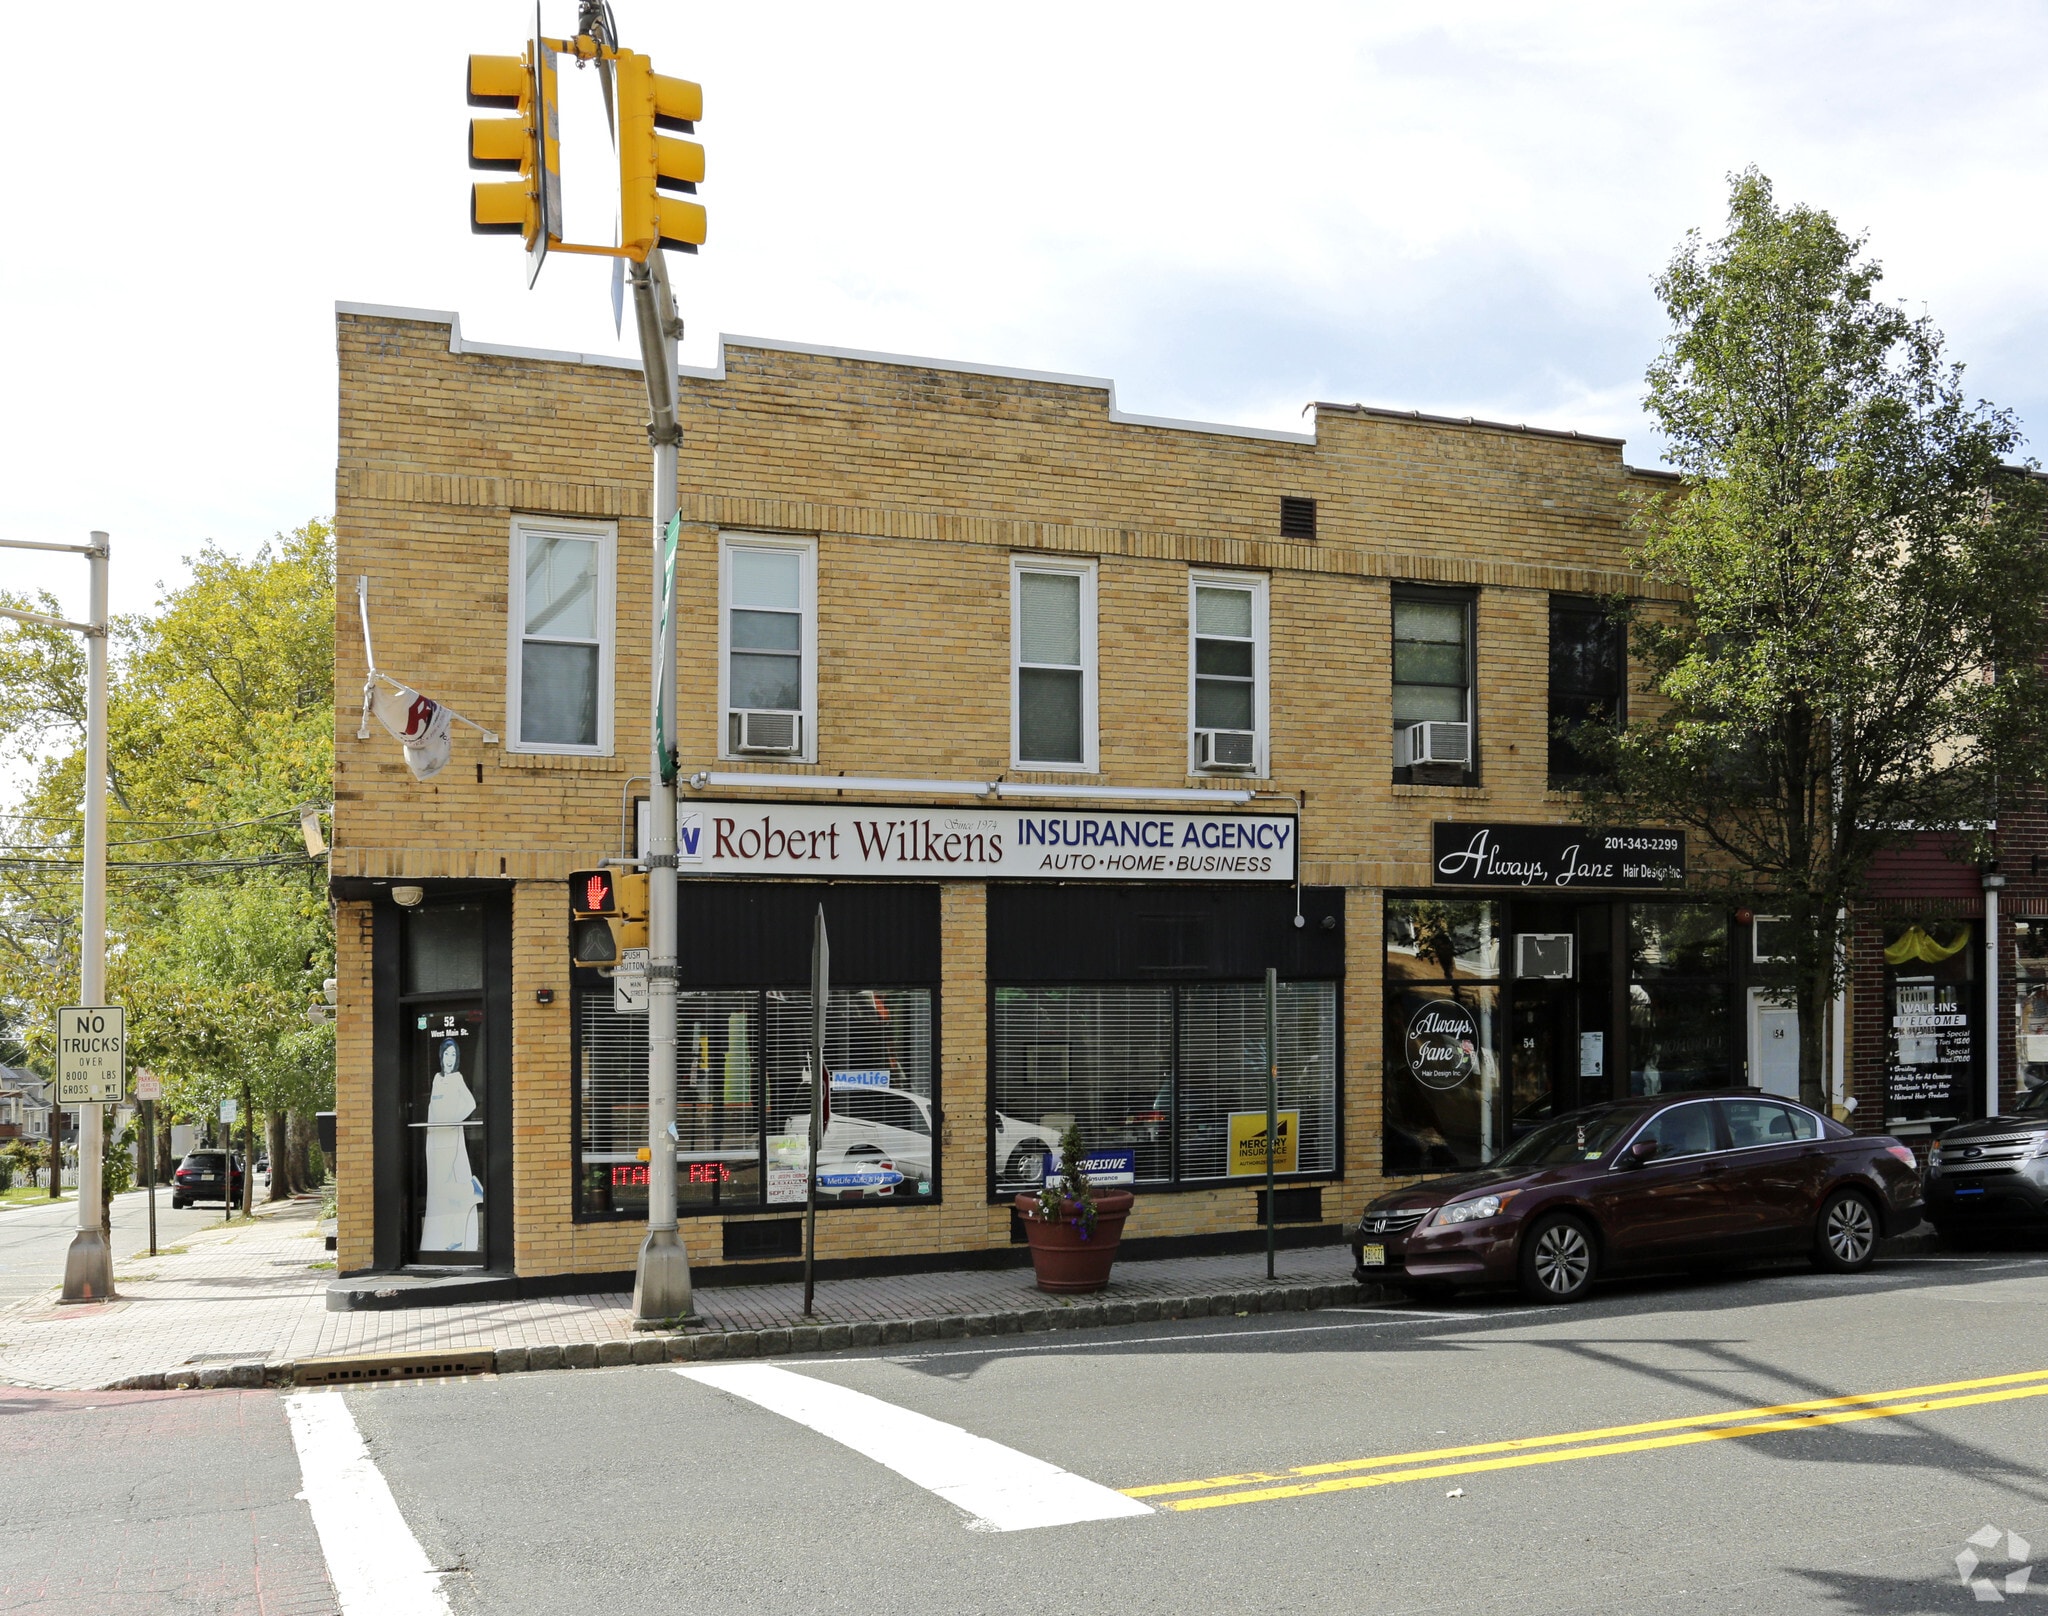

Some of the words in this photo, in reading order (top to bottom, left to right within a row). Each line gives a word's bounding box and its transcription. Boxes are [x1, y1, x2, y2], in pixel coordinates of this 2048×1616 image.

[944, 818, 973, 830] Since
[976, 820, 998, 830] 1974
[712, 816, 840, 861] Robert
[853, 818, 1003, 863] Wilkens
[1017, 818, 1174, 848] INSURANCE
[1181, 822, 1290, 850] AGENCY
[1604, 836, 1678, 850] 201-343-2299
[1438, 829, 1549, 886] Always,
[1555, 844, 1614, 886] Jane
[1623, 864, 1640, 878] Hair
[1640, 864, 1668, 881] Design
[624, 952, 640, 960] PUSH
[621, 962, 644, 970] BUTTON
[1902, 1002, 1958, 1013] WALK-INS
[77, 1016, 105, 1033] NO
[444, 1016, 455, 1027] 52
[1410, 1012, 1473, 1040] Always,
[431, 1030, 445, 1038] West
[446, 1028, 459, 1037] Main
[460, 1028, 469, 1036] St.
[1946, 1030, 1970, 1038] Special
[63, 1038, 119, 1052] TRUCKS
[1523, 1038, 1535, 1048] 54
[1412, 1040, 1454, 1069] Jane
[1946, 1048, 1970, 1056] Special
[79, 1057, 103, 1066] OVER
[66, 1071, 88, 1080] 8000
[101, 1070, 116, 1080] LBS
[835, 1072, 888, 1084] MetLife
[1434, 1070, 1452, 1078] Design
[63, 1084, 89, 1094] GROSS
[105, 1084, 116, 1093] WT
[1240, 1138, 1287, 1149] MERCRY
[851, 1176, 866, 1184] Auto
